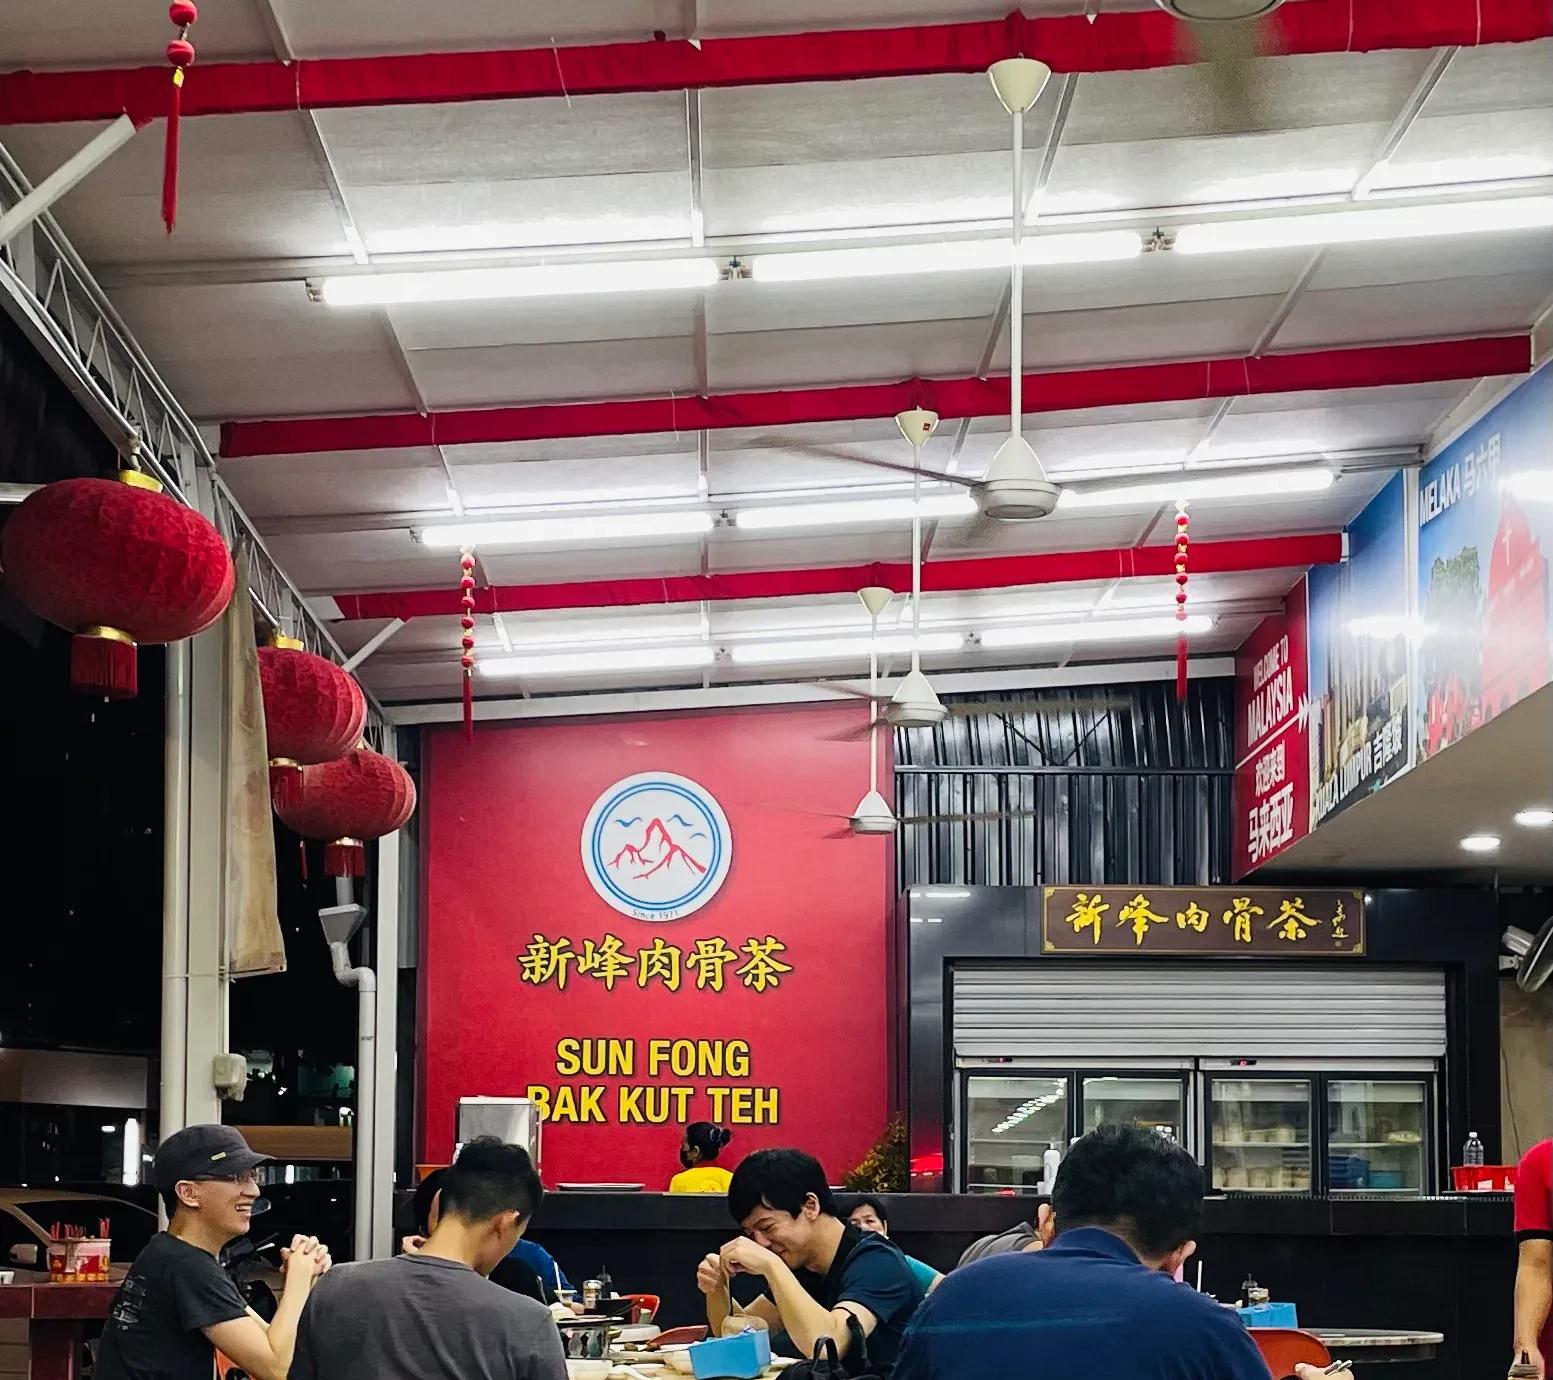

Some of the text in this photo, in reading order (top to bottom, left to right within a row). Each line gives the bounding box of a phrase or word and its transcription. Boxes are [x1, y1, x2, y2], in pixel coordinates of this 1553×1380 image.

[1420, 432, 1501, 528] MELAKA 马六甲
[1253, 634, 1289, 692] WELCOME TO
[1247, 665, 1294, 747] MALAYSIA
[1255, 739, 1286, 798] 欢迎来到
[1340, 740, 1373, 801] LUMPUR
[1373, 713, 1403, 774] 吉隆坡
[1247, 782, 1294, 863] 马来西亚
[632, 909, 655, 920] Since
[518, 933, 793, 991] 新峰肉骨茶
[556, 1038, 749, 1076] SUN FONG
[527, 1086, 779, 1124] BAK KUT TEH
